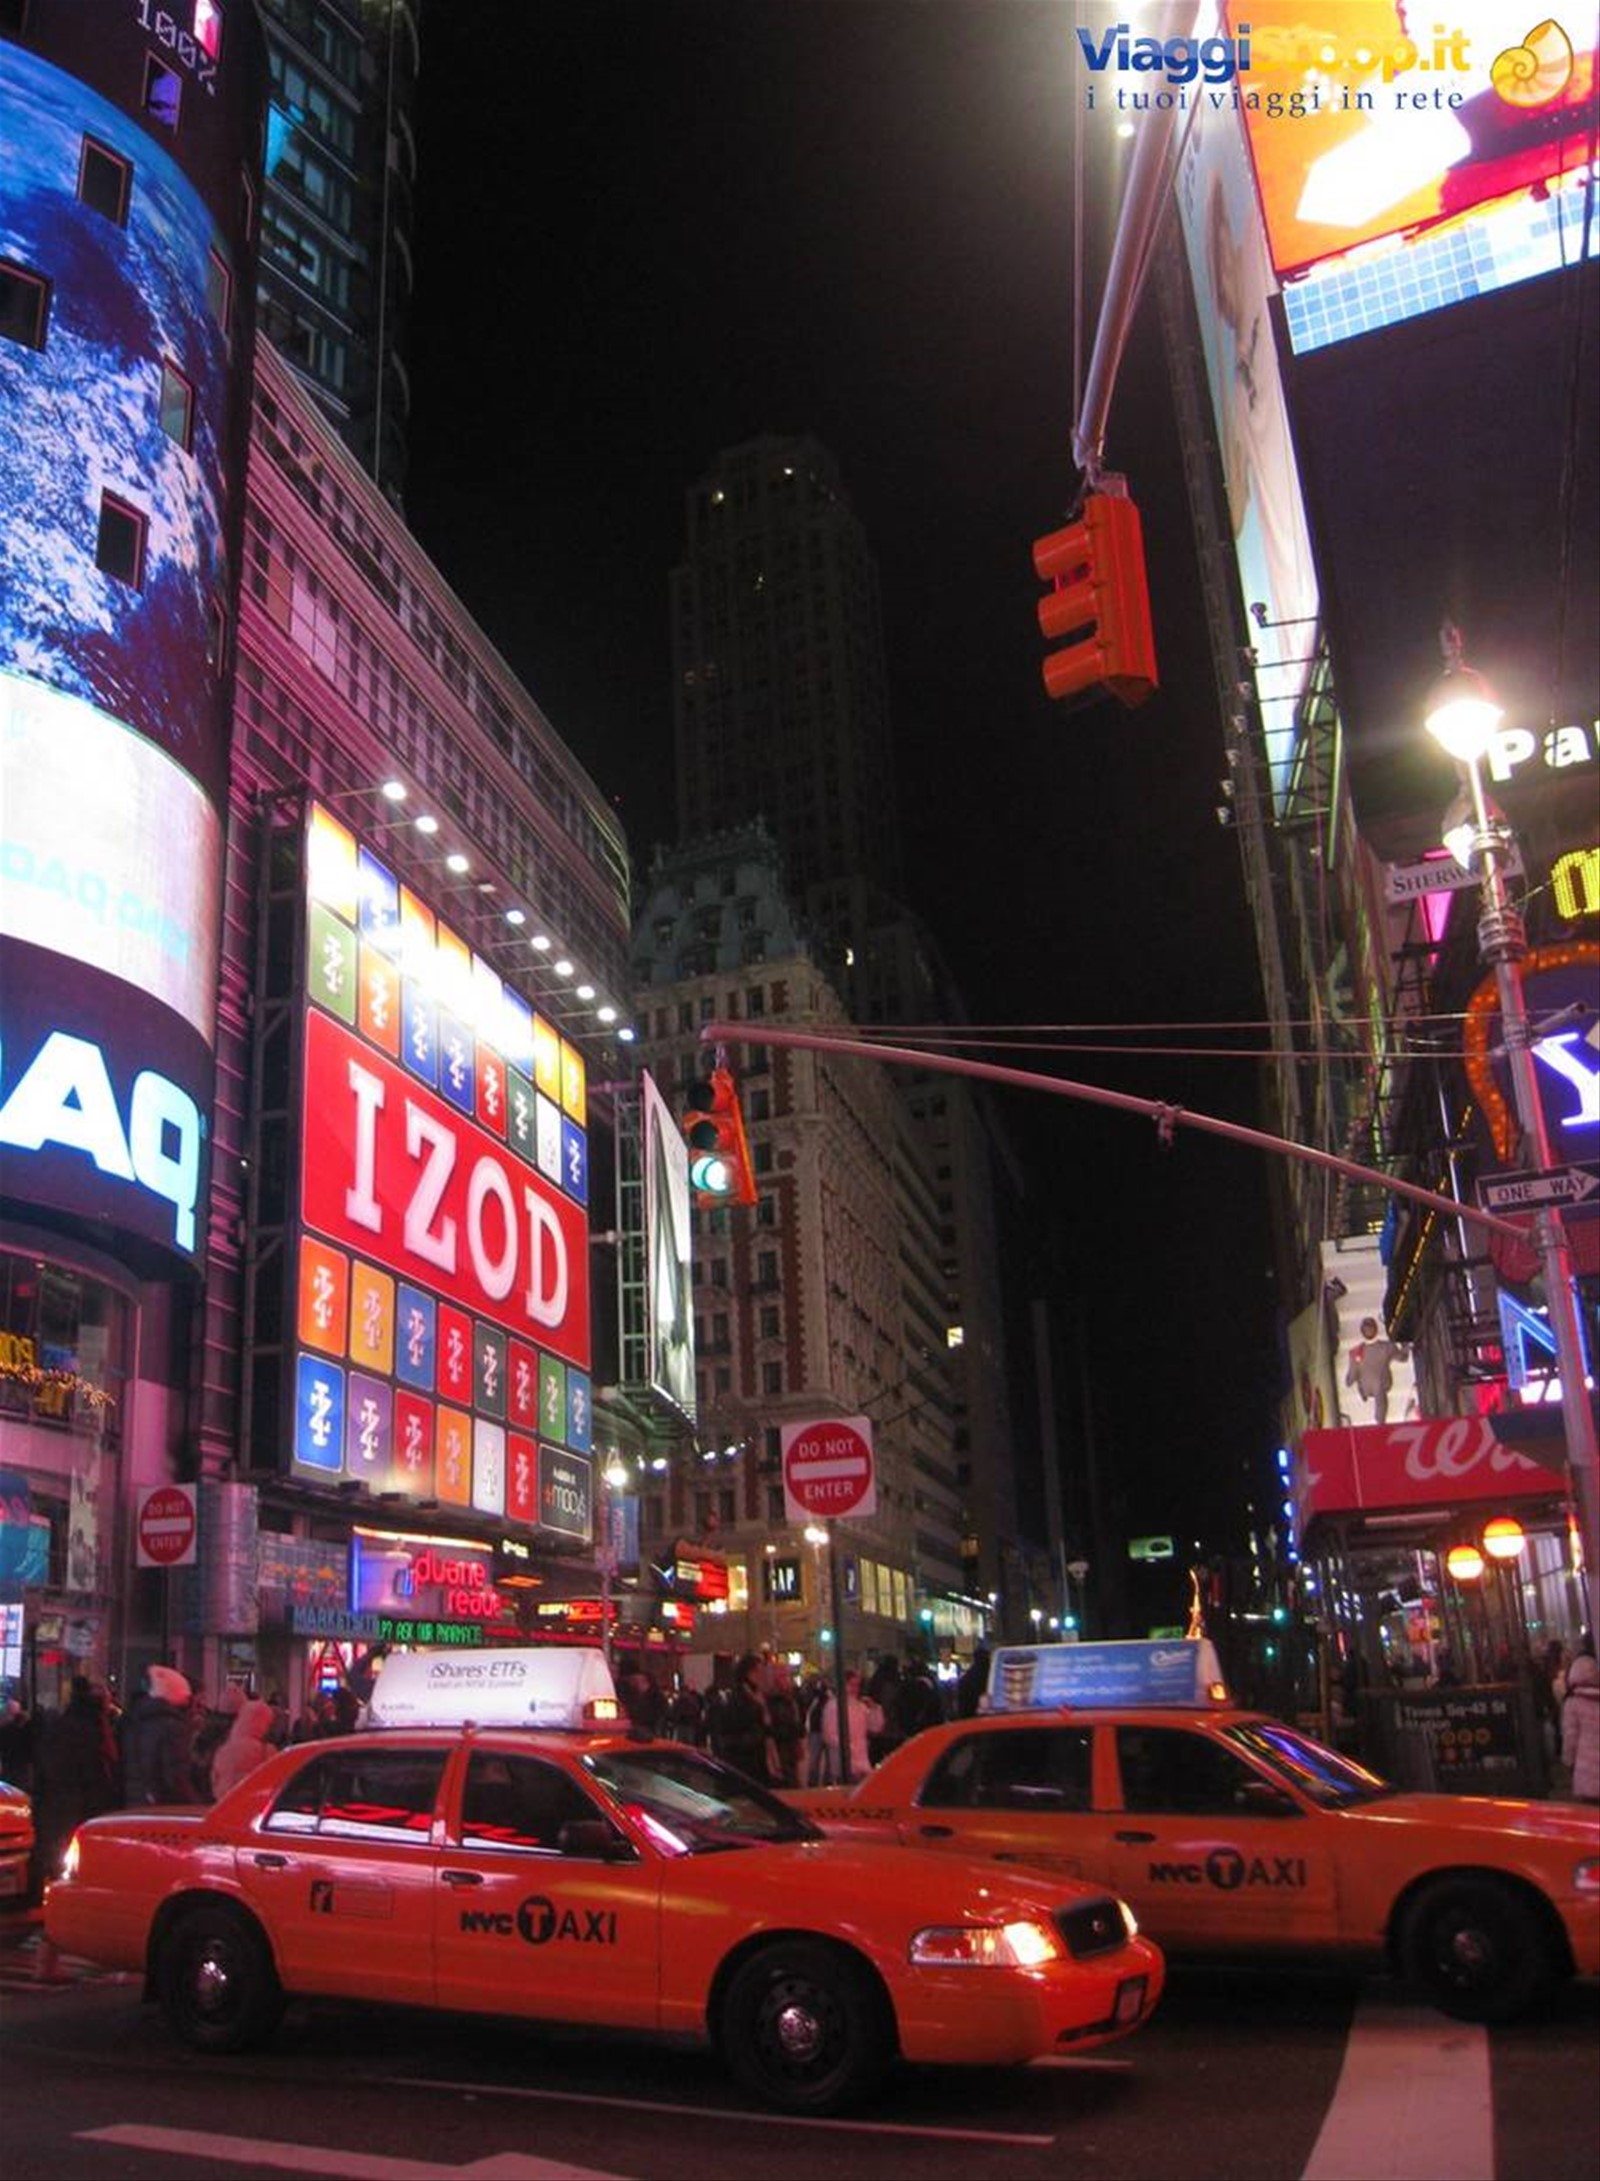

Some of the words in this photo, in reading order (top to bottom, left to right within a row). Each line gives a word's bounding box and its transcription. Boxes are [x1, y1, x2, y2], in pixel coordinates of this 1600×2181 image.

[345, 1057, 568, 1330] IZOD
[1497, 1183, 1533, 1201] ONE
[1549, 1175, 1588, 1195] WAY
[798, 1441, 820, 1458] DO
[825, 1438, 855, 1456] NOT
[804, 1480, 854, 1500] ENTER
[148, 1502, 164, 1517] DO
[165, 1500, 186, 1515] NOT
[149, 1533, 183, 1550] ENTER
[412, 1549, 486, 1596] duane
[488, 1660, 527, 1678] ETFs
[1147, 1862, 1202, 1884] NYC
[1205, 1848, 1308, 1891] TAXI
[460, 1910, 514, 1936] NYC
[517, 1896, 618, 1945] TAXI
